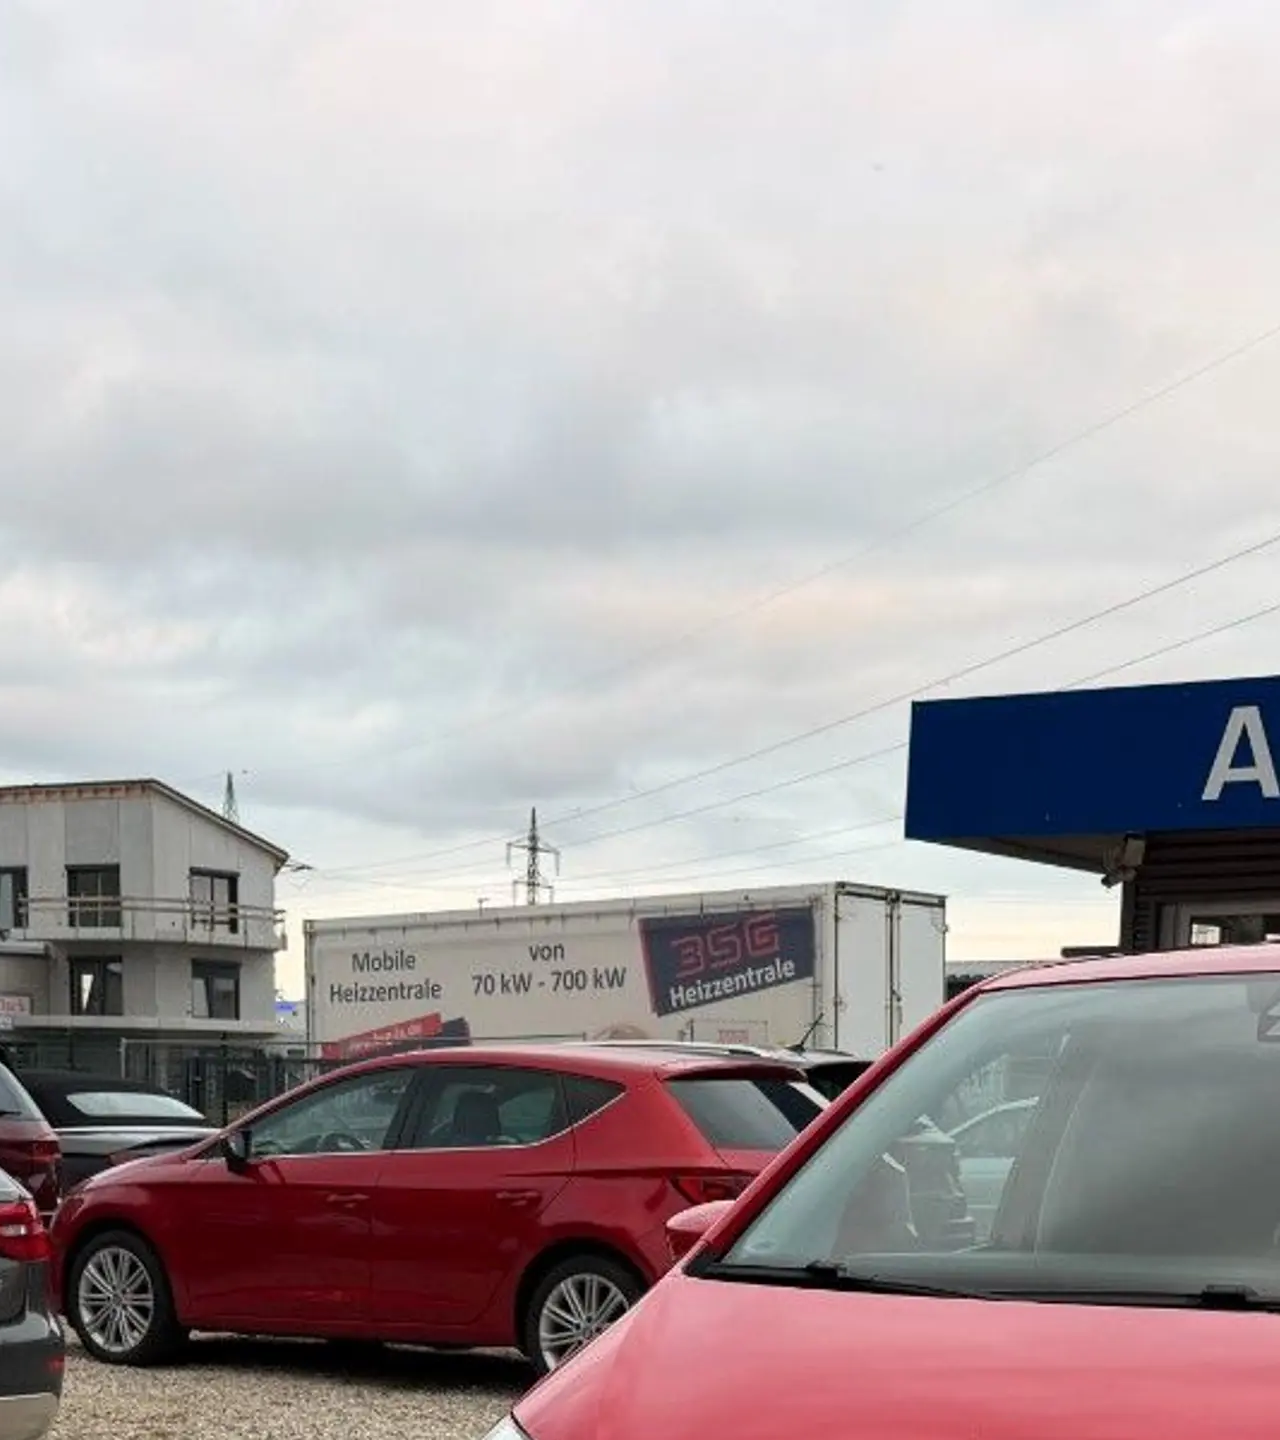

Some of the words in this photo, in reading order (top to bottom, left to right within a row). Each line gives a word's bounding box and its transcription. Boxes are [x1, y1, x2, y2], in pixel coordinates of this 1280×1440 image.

[351, 949, 417, 973] Mobile
[528, 942, 565, 962] von
[329, 977, 443, 1004] Heizzentrale
[471, 974, 496, 995] 70
[500, 972, 533, 994] kW
[551, 969, 588, 992] 700
[592, 966, 627, 990] kW
[669, 957, 796, 1008] Heizzentrale
